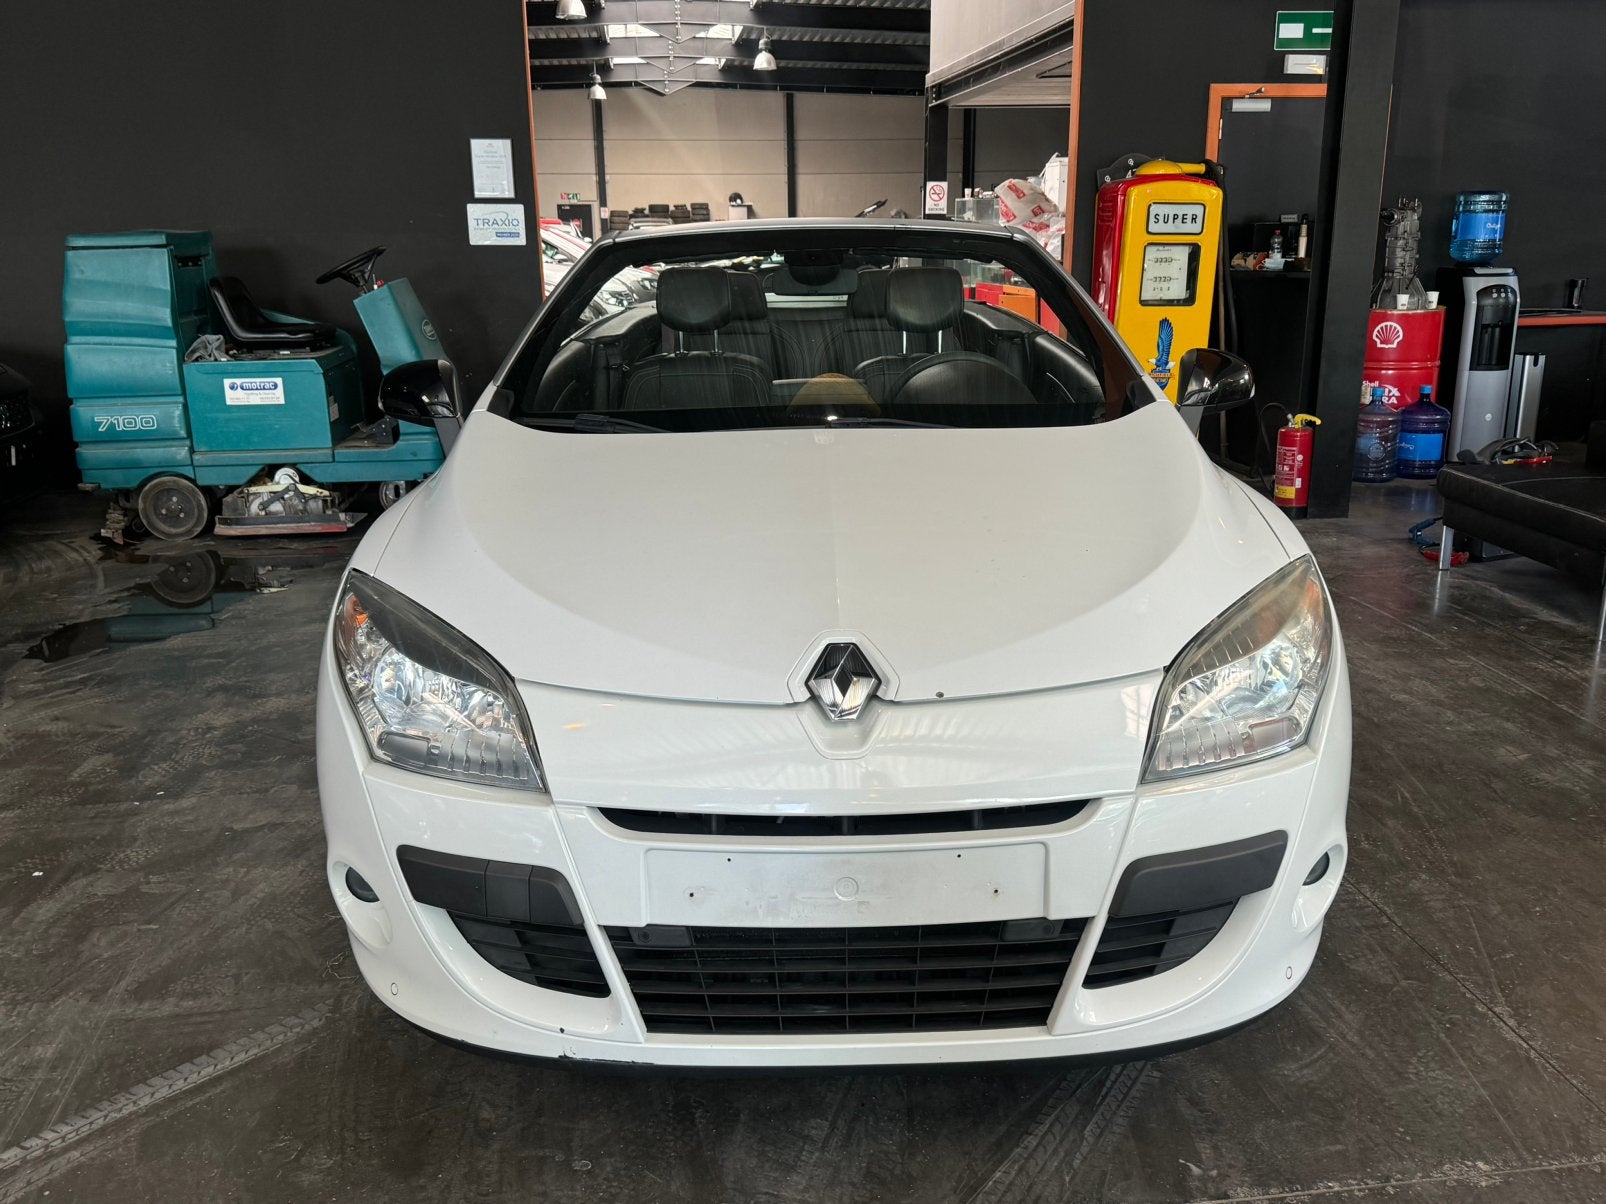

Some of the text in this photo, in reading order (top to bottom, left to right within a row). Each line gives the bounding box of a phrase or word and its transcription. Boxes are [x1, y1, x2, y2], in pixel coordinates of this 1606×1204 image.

[473, 217, 520, 227] TRAXIO
[1153, 213, 1198, 224] SUPER
[243, 382, 275, 390] motrac
[94, 415, 157, 431] 7100
